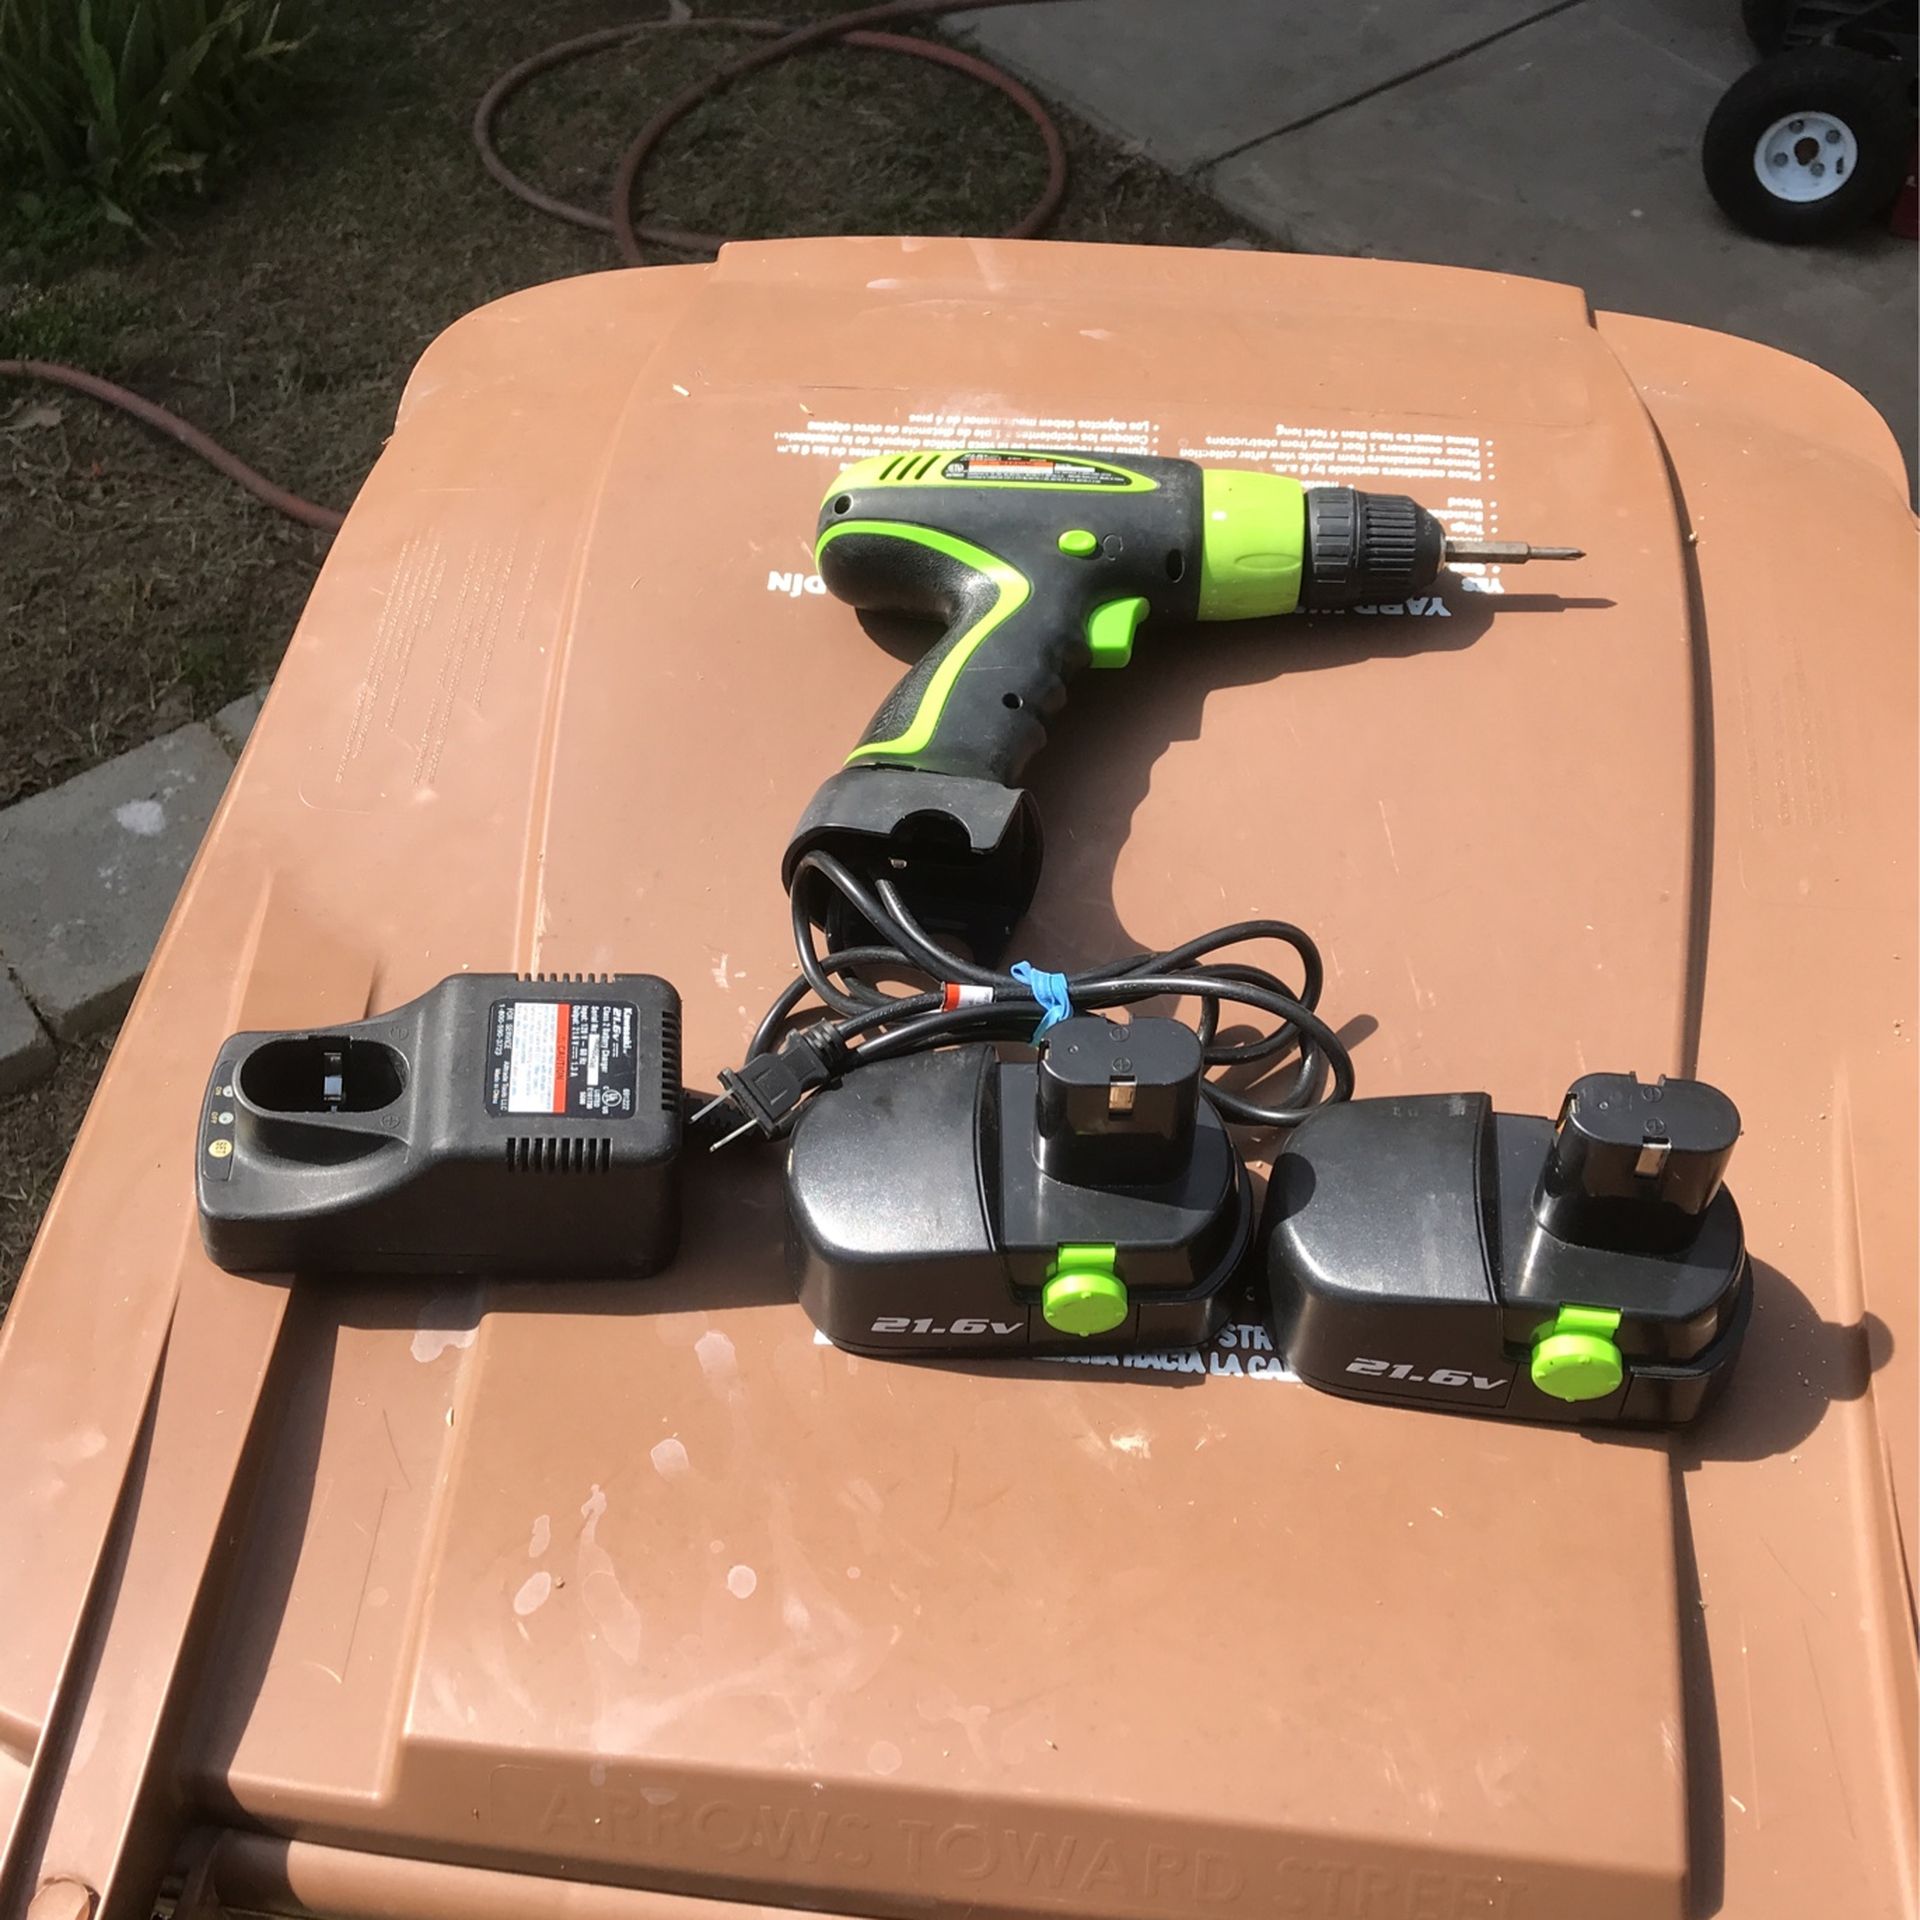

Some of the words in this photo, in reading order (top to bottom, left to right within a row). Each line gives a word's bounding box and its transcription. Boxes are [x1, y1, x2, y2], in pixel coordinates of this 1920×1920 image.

[909, 413, 934, 424] pies
[946, 414, 961, 425] de
[1039, 418, 1075, 429] deben
[808, 421, 851, 433] objetos
[853, 424, 882, 434] otros
[884, 424, 900, 435] de
[902, 426, 955, 438] distancia
[1128, 421, 1150, 432] Los
[1276, 424, 1302, 438] long
[956, 428, 972, 438] de
[973, 428, 992, 439] pie
[1081, 432, 1098, 443] los
[1100, 431, 1148, 445] Coloque
[1304, 428, 1328, 439] feet
[1341, 430, 1368, 441] than
[1370, 432, 1394, 442] less
[1396, 433, 1411, 443] be
[842, 435, 853, 446] la
[855, 436, 870, 446] de
[872, 436, 921, 450] después
[1281, 440, 1308, 450] from
[1310, 440, 1339, 450] away
[1413, 434, 1443, 445] must
[1446, 436, 1479, 447] Items
[812, 446, 830, 456] las
[832, 446, 847, 456] de
[849, 447, 881, 457] antes
[1342, 442, 1368, 453] foot
[1380, 444, 1443, 456] containers
[1446, 447, 1480, 458] Place
[1180, 448, 1237, 460] collection
[1239, 450, 1268, 461] after
[1270, 451, 1296, 462] view
[1298, 452, 1335, 463] public
[1337, 454, 1366, 464] from
[1368, 454, 1431, 466] containers
[1433, 458, 1481, 470] Remove
[1272, 464, 1298, 474] a.m.
[1312, 463, 1326, 474] by
[1328, 465, 1380, 477] curbside
[1382, 467, 1446, 479] containers
[1448, 470, 1482, 482] Place
[1447, 497, 1484, 509] Wood
[1450, 522, 1484, 536] Twigs
[1460, 576, 1504, 594] YES
[506, 1008, 514, 1020] FOR
[590, 1006, 600, 1022] Serial
[622, 1008, 632, 1050] Kawasaki
[504, 1024, 512, 1050] SERVICE
[602, 1028, 610, 1048] Battery
[556, 1045, 566, 1080] CAUTION
[600, 1050, 610, 1073] Charger
[501, 1083, 509, 1098] Tools
[492, 1089, 500, 1104] China
[500, 1099, 508, 1111] LLC
[1210, 1351, 1244, 1378] LA
[536, 1783, 872, 1870] ARROWS
[899, 1818, 1250, 1904] TOWARD
